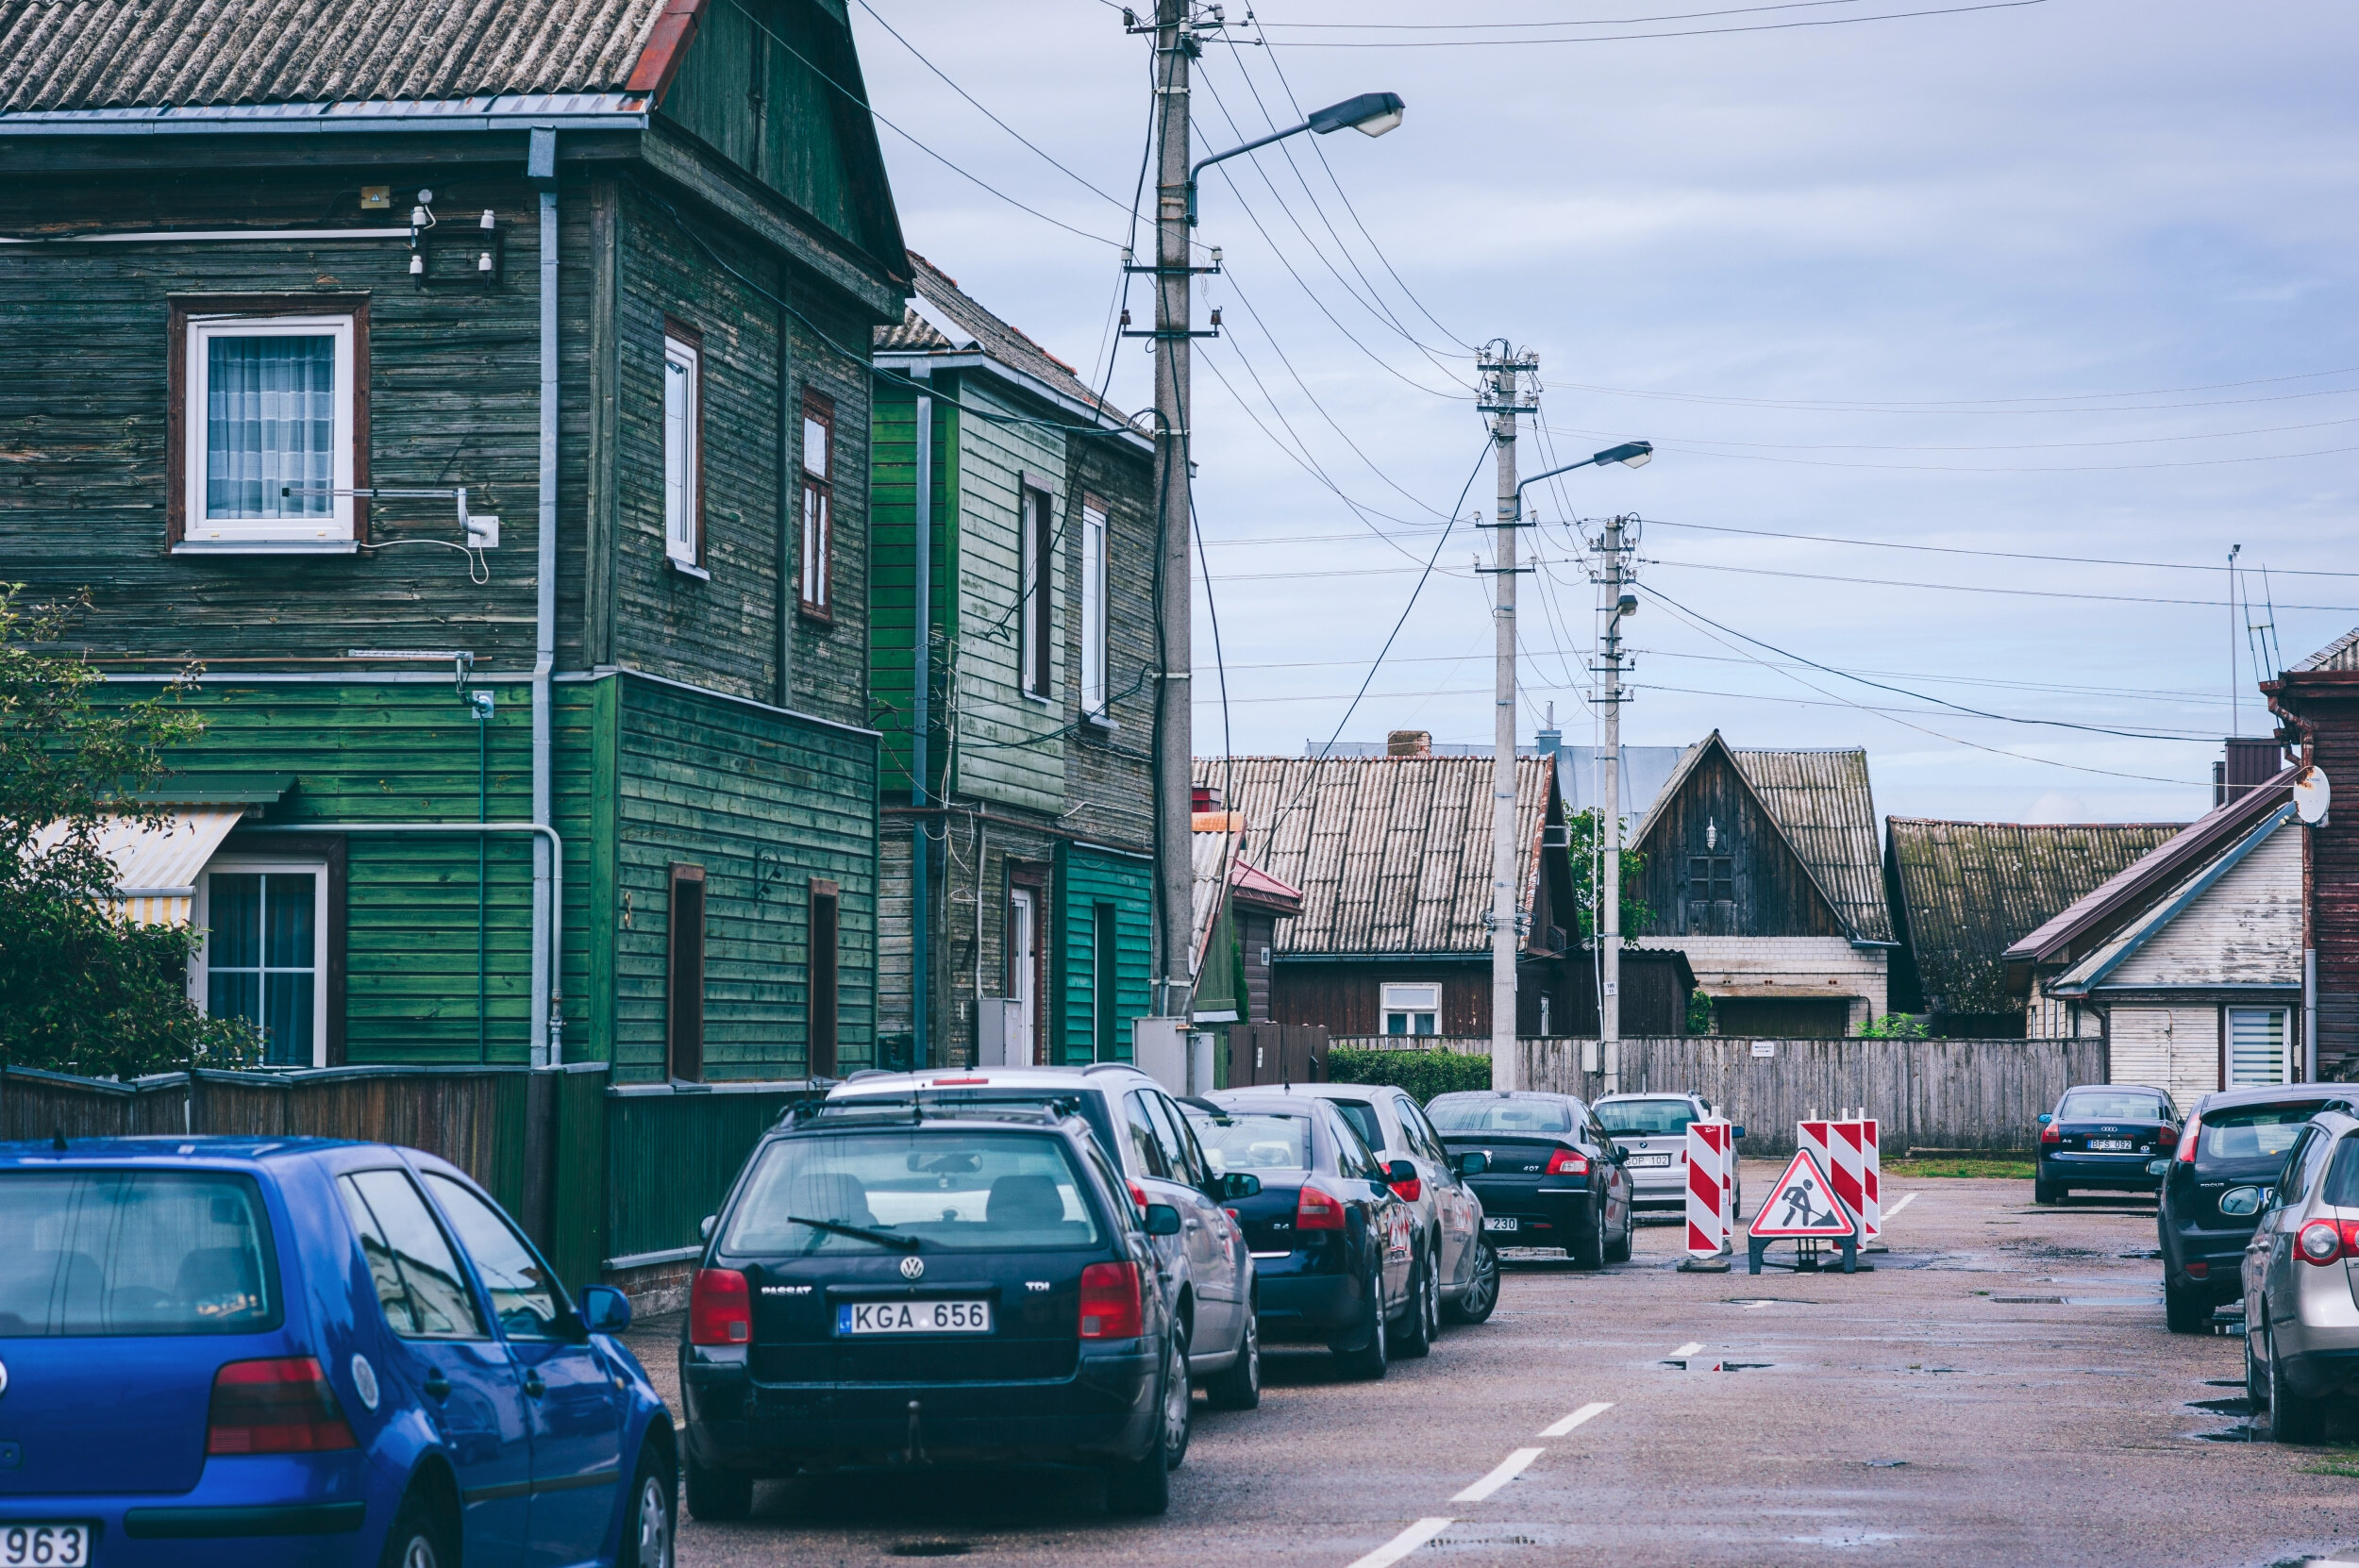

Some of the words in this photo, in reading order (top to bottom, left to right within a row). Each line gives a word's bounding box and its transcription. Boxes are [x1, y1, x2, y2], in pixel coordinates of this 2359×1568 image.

[2092, 1140, 2110, 1148] BFS
[2115, 1140, 2131, 1149] 092
[1651, 1156, 1667, 1165] 102
[1494, 1218, 1515, 1229] 230
[855, 1305, 914, 1329] KGA
[933, 1304, 983, 1327] 656
[6, 1526, 81, 1564] 963
